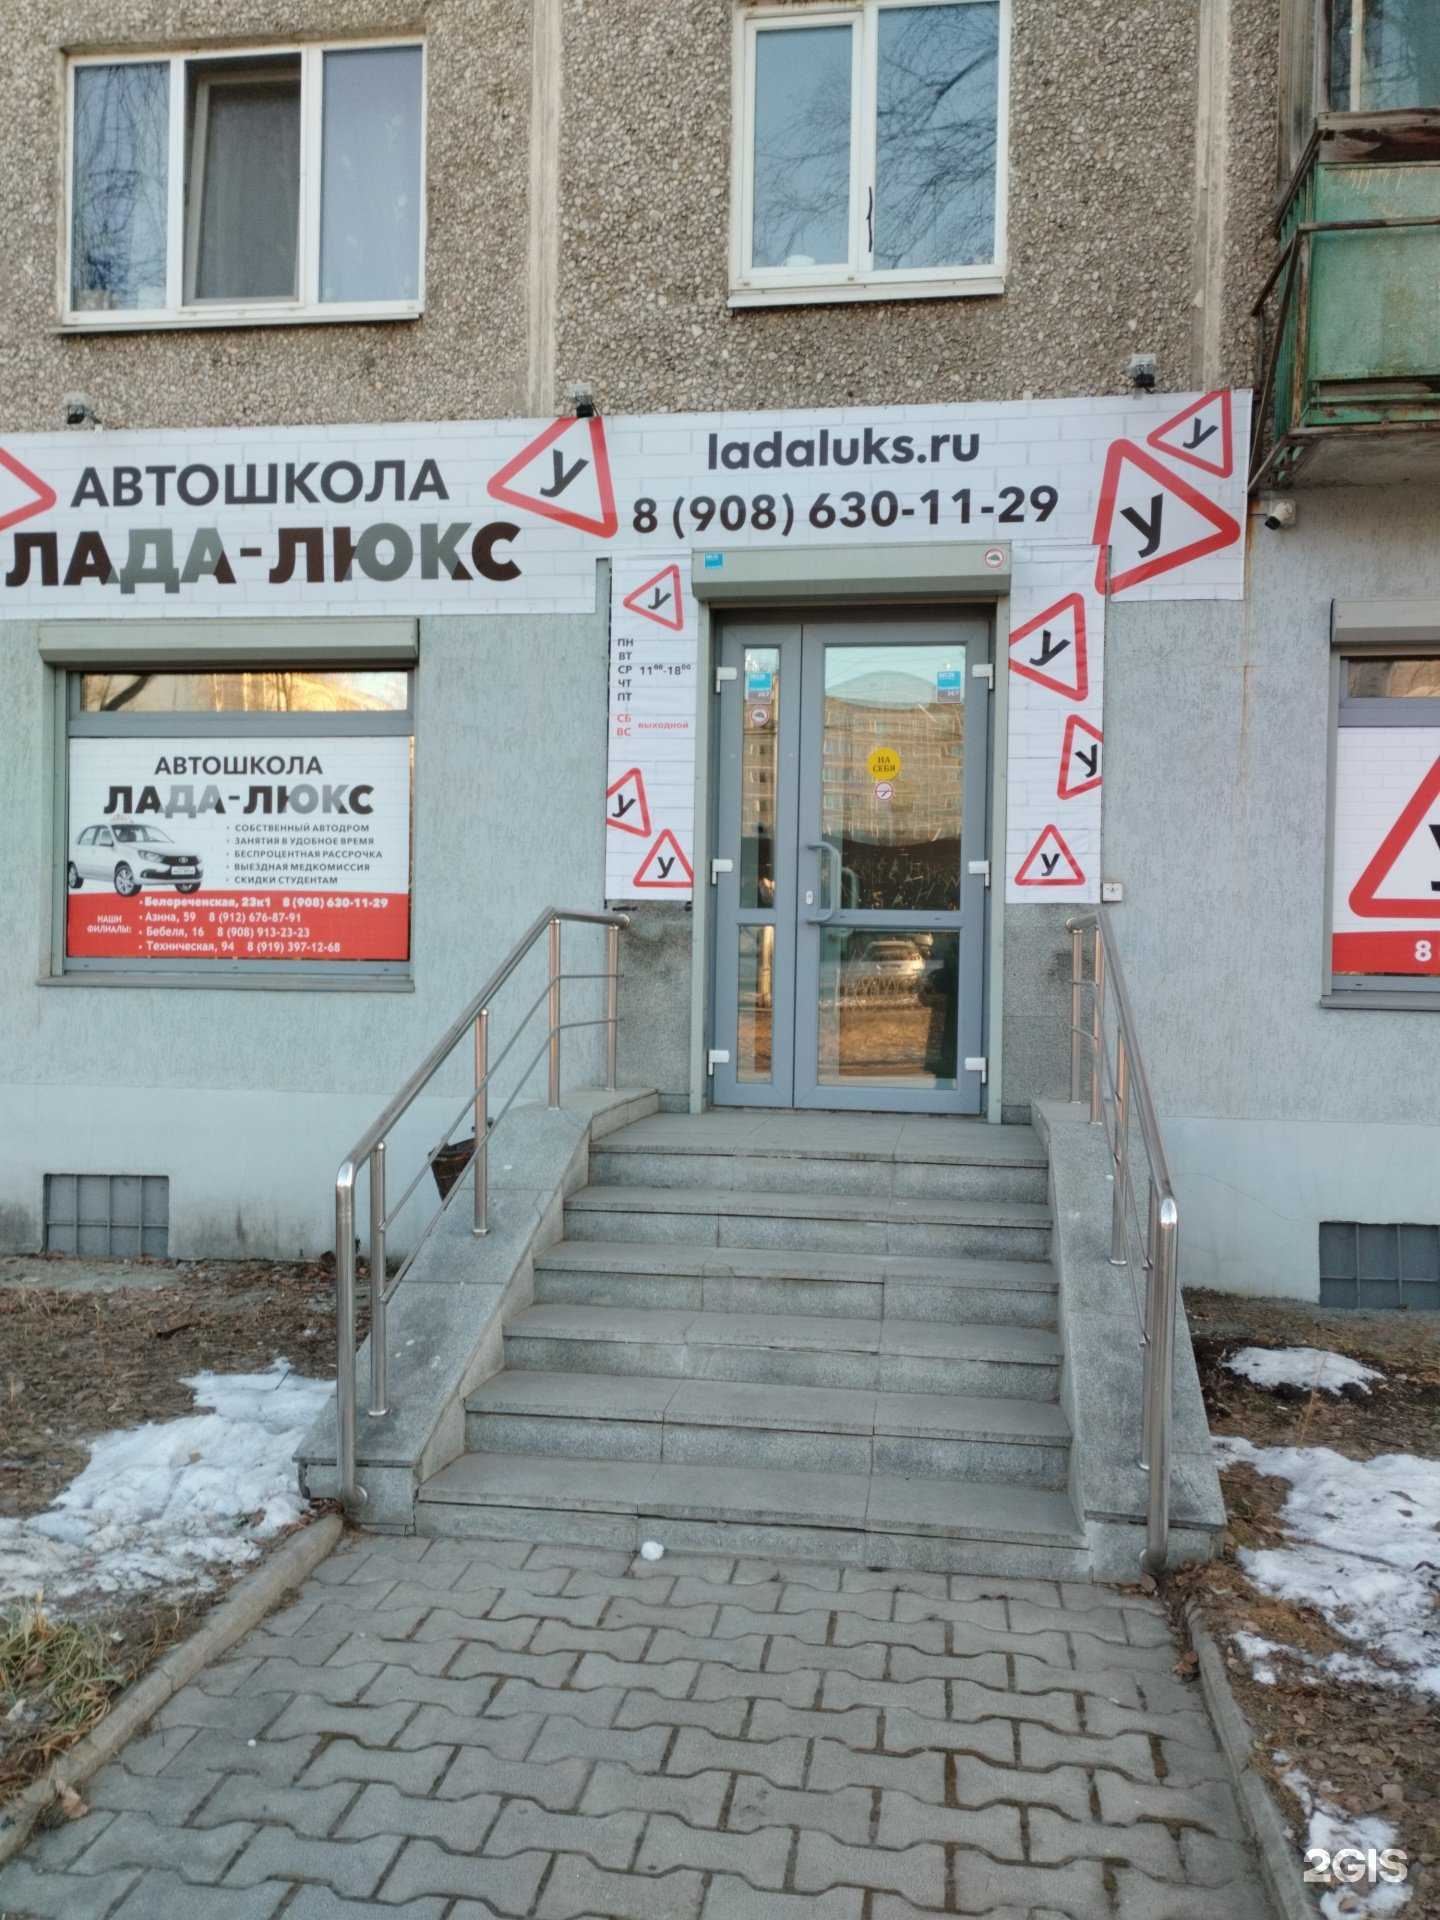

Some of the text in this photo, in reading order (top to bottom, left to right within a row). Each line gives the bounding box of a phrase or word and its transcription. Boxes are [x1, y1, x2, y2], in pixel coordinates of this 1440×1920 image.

[708, 428, 980, 470] ladaluks.ru
[70, 459, 450, 508] АВТОШКОЛА
[632, 485, 1059, 539] 8 (908) 630-11-29
[5, 521, 522, 594] ЛАДА-ЛЮКС
[617, 638, 634, 647] ПН
[619, 652, 632, 661] ВТ
[618, 665, 632, 674] СР
[618, 679, 632, 688] ЧТ
[617, 693, 632, 702] ПТ
[617, 714, 631, 723] СБ
[638, 721, 688, 730] выходной
[616, 728, 631, 737] ВС
[154, 756, 323, 775] АВТОШКОЛА
[104, 784, 374, 818] ЛАДА-ЛЮКС
[235, 823, 369, 832] СОБСТВЕННЫЙ АВТОДРОМ
[234, 837, 279, 845] ЗАНЯТИЯ
[290, 837, 338, 846] УДОБНОЕ
[340, 837, 374, 845] ВРЕМЯ
[234, 850, 383, 859] БЕСПРОЦЕНТНАЯ РАССРОЧКА
[234, 863, 370, 872] ВЫЕЗДНАЯ МЕДКОМИССИЯ
[234, 876, 338, 885] СКИДКИ СТУДЕНТАМ
[292, 897, 325, 909] (908)
[97, 915, 123, 923] НАШИ
[145, 912, 301, 923] Азина, 59 8 (912) 676-87-91
[146, 927, 310, 938] Бебеля, 16 8 (908) 913-23-23
[146, 941, 341, 953] Техническая, 94 8 (919) 397-12-68
[1414, 939, 1432, 961] 8
